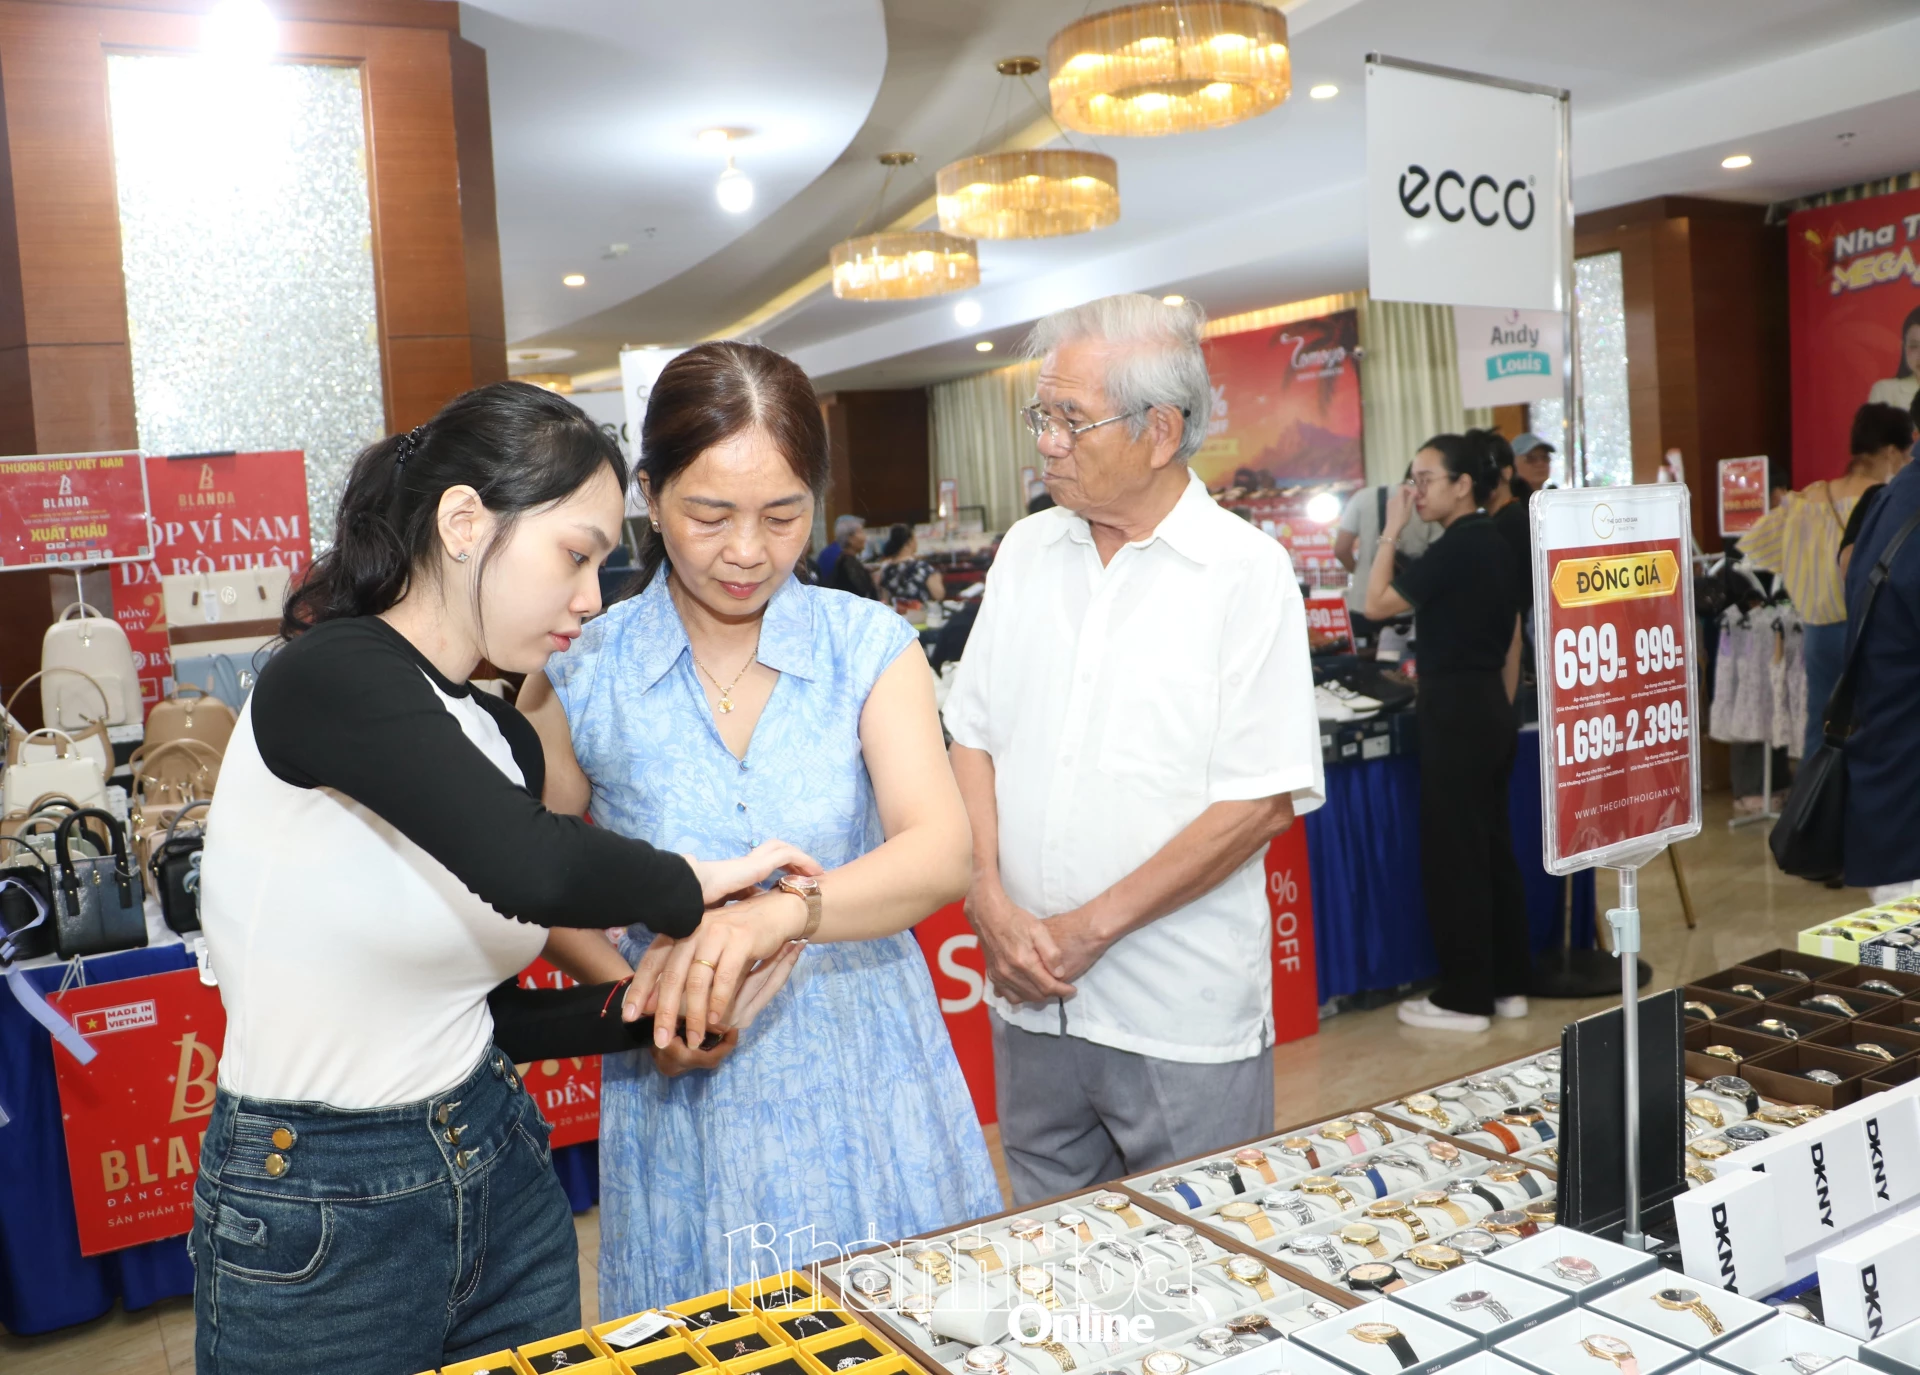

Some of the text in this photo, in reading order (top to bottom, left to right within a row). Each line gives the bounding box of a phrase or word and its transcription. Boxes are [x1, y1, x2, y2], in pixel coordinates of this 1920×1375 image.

[1398, 164, 1535, 230] ecco
[1835, 213, 1920, 258] Nha T
[1490, 325, 1540, 348] Andy
[1496, 354, 1542, 375] Louis
[100, 457, 124, 468] NAM
[42, 496, 89, 509] BLANDA
[178, 491, 236, 507] BLANDA
[30, 523, 66, 541] XUẤT
[70, 519, 108, 539] KHẨU
[189, 512, 222, 544] VÍ
[231, 515, 300, 543] NAM
[1577, 558, 1661, 593] ĐỒNG GIÁ
[1555, 623, 1675, 690] 699 999
[1556, 714, 1615, 766] 1.699
[1626, 700, 1682, 751] 2.399
[1574, 786, 1680, 819] WWW.THEGIOITHOIGIAN.VN
[1276, 911, 1301, 973] OFF
[107, 1004, 152, 1018] MADE IN
[108, 1015, 153, 1028] VIETNAM
[100, 1133, 204, 1192] BLA
[1866, 1117, 1890, 1201] DKNY
[1810, 1142, 1834, 1228] DKNY
[1711, 1202, 1739, 1294] DKNY
[1861, 1264, 1885, 1340] DKN
[1426, 1364, 1442, 1374] TIMEX
